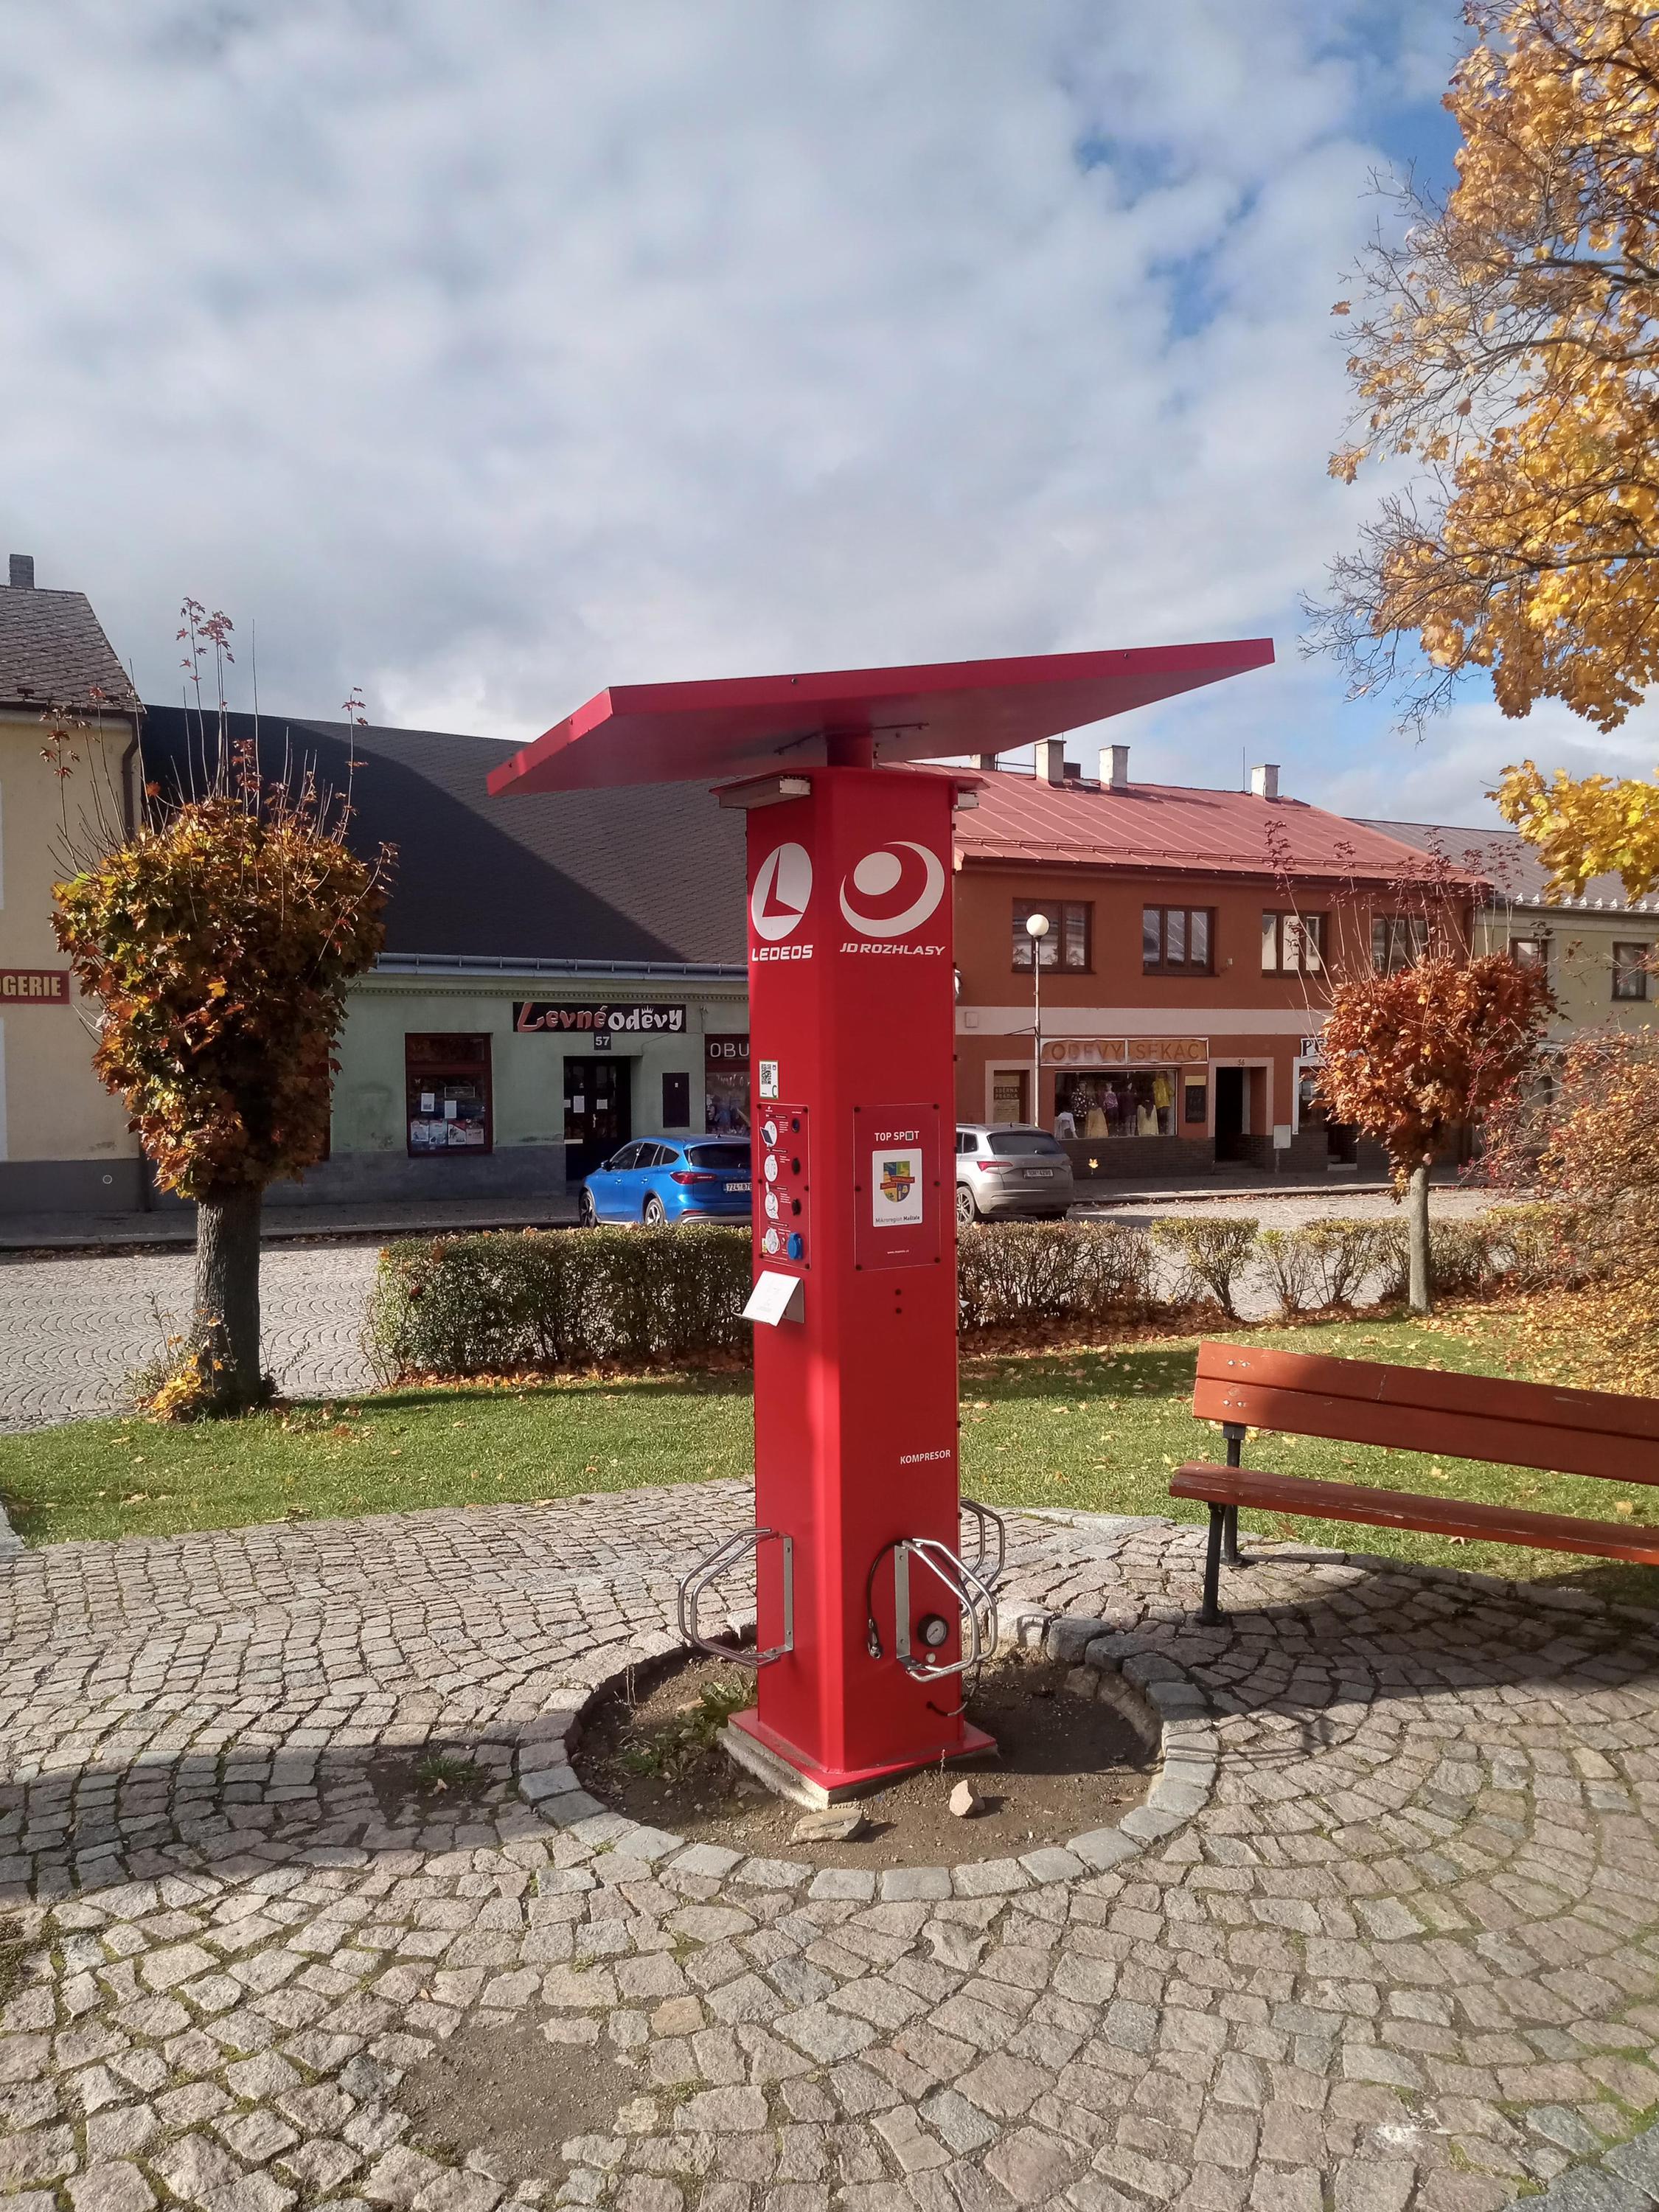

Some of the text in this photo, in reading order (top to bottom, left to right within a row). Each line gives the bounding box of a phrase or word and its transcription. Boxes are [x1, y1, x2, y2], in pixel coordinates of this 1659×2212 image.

[751, 945, 813, 961] LEDEOS
[840, 942, 945, 956] JD ROZHLASY
[0, 975, 61, 997] GERIE
[595, 1037, 610, 1046] 57
[874, 1132, 891, 1141] TOP
[900, 1449, 951, 1464] KOMPRESOR
